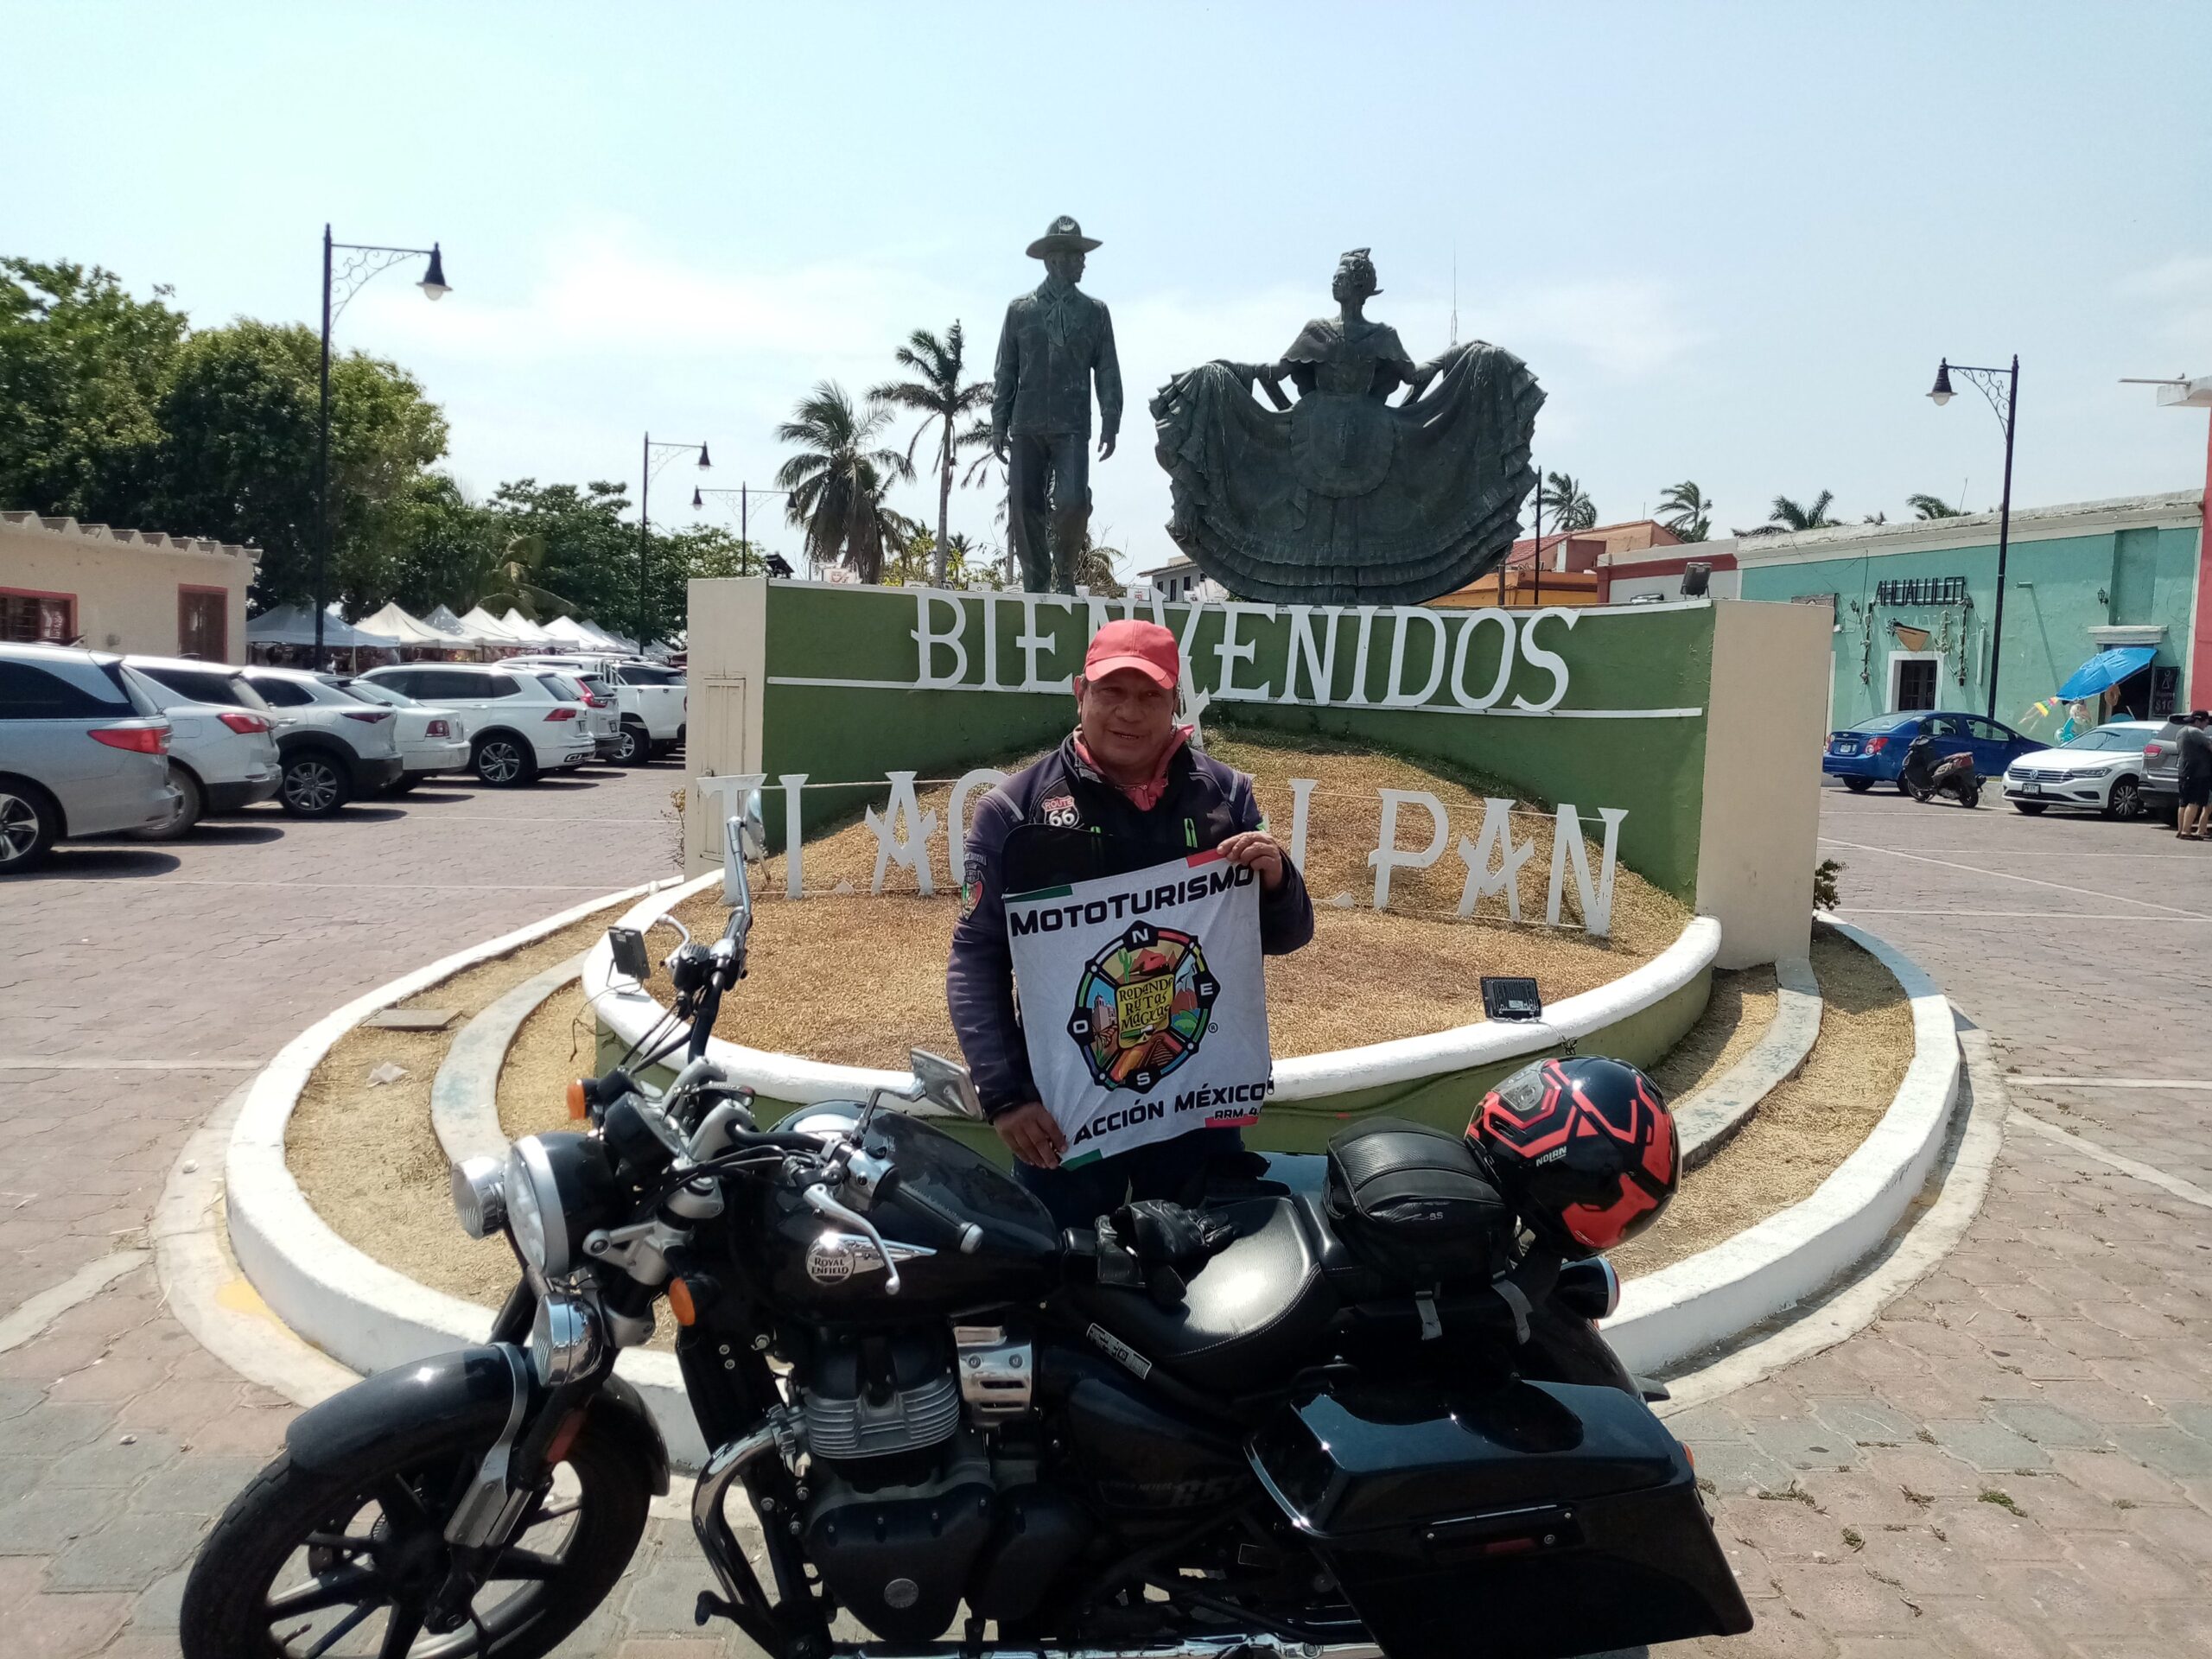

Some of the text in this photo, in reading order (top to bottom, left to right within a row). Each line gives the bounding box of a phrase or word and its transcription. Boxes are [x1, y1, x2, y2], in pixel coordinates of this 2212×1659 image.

[1045, 799, 1072, 810] ROUTE
[1049, 808, 1075, 826] 66
[1010, 864, 1253, 937] MOTOTURISMO
[1132, 928, 1149, 943] N
[1200, 983, 1213, 996] E
[1073, 1020, 1088, 1033] O
[1136, 1072, 1151, 1085] S
[1073, 1083, 1266, 1146] ACCIÓN MÉXICO
[1215, 1106, 1262, 1120] RRM 4.
[1535, 1146, 1567, 1167] NOLAN
[815, 1257, 844, 1267] ROYAL
